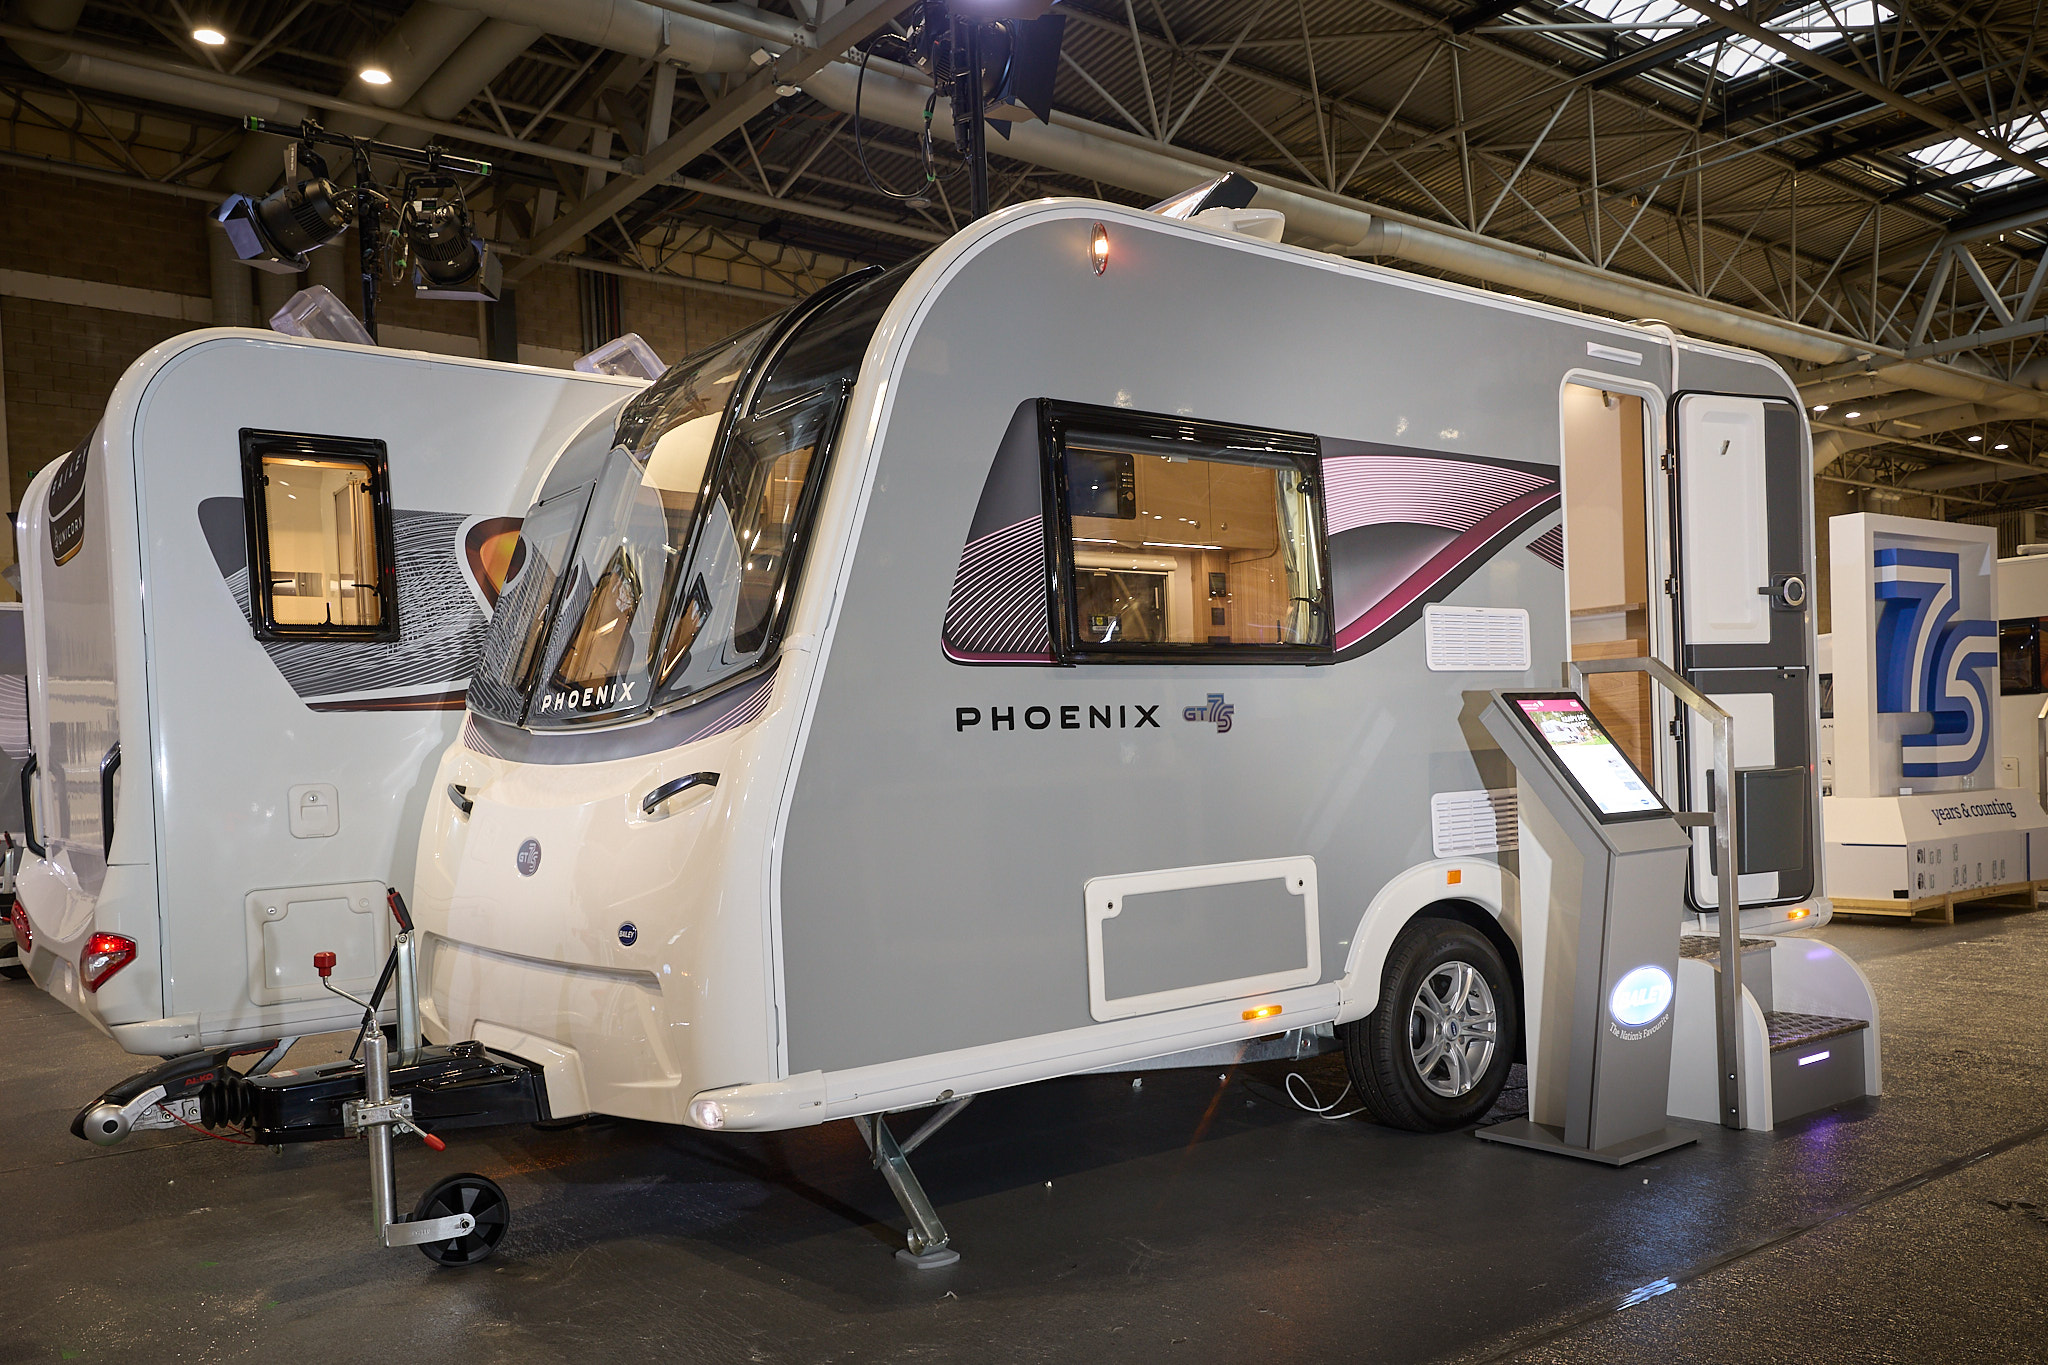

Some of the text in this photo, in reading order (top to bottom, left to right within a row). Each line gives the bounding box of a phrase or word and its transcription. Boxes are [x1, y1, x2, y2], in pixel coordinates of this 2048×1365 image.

[51, 445, 88, 496] BAILEY
[58, 515, 83, 545] UNICORN
[541, 681, 636, 713] PHOENIX
[955, 705, 1161, 732] PHOENIX
[1931, 798, 2017, 826] years & counting
[618, 930, 635, 939] BAILEY
[1609, 1013, 1670, 1041] The Nation's Favourite
